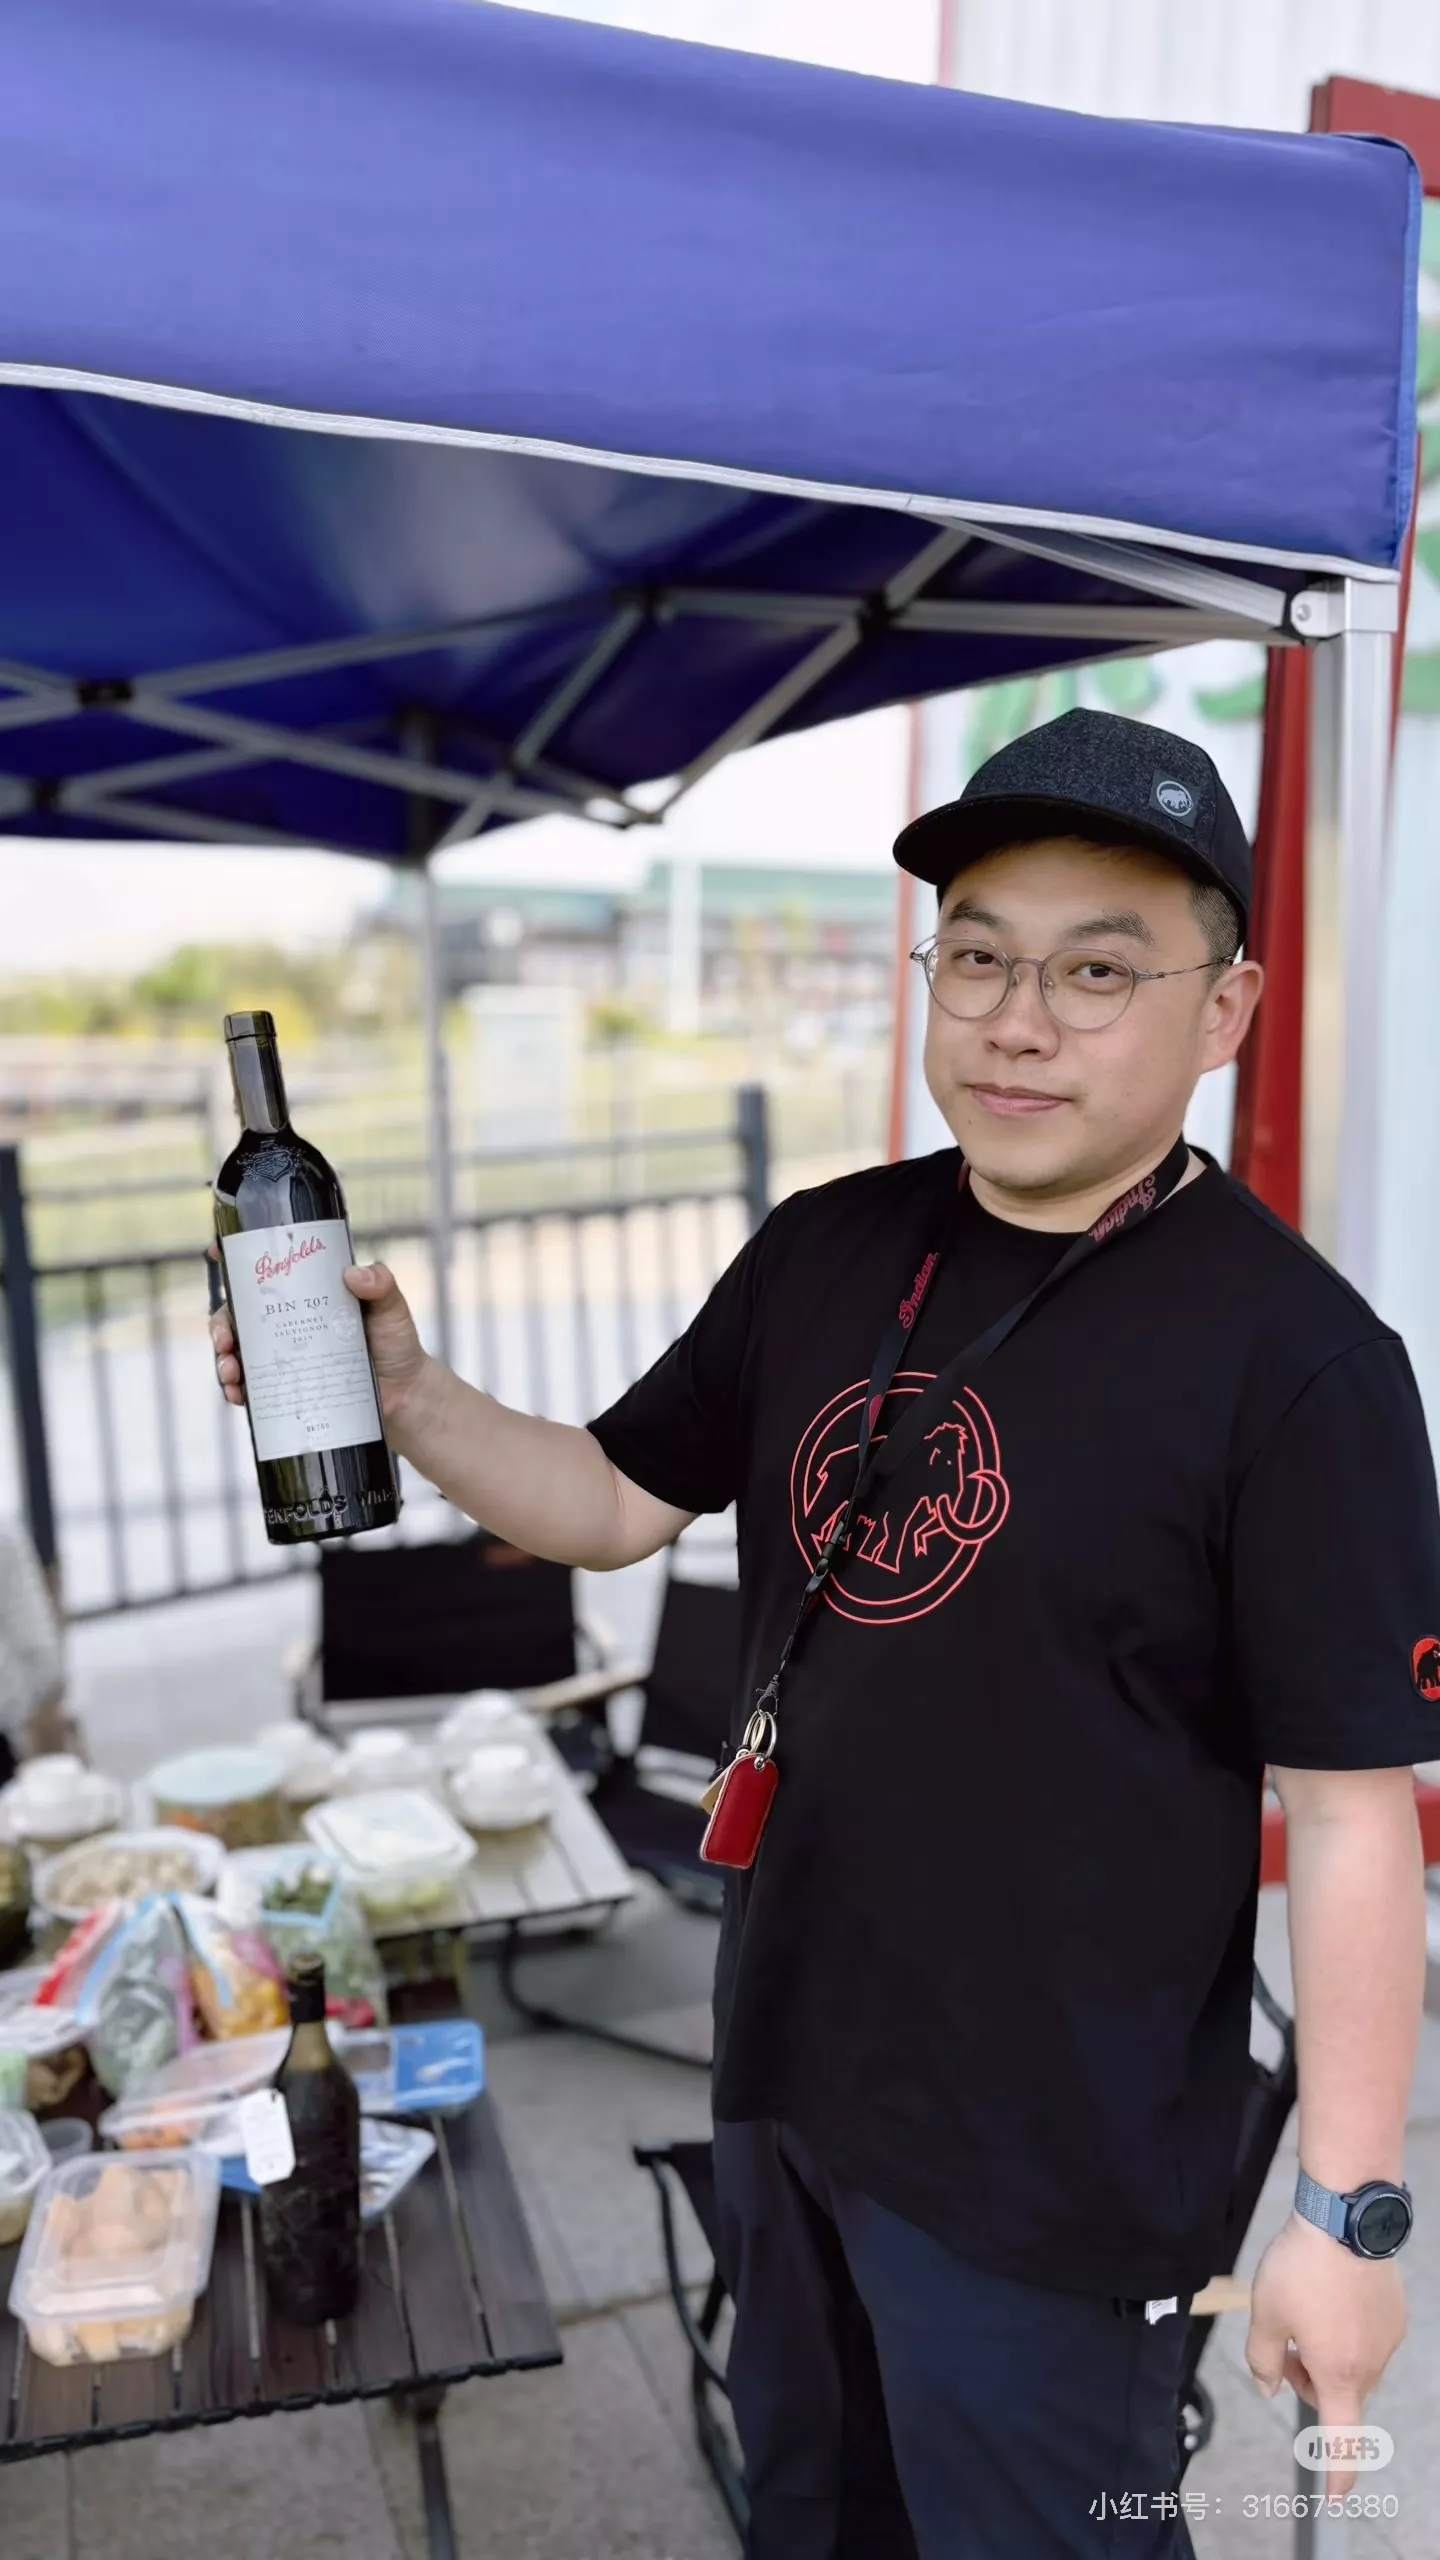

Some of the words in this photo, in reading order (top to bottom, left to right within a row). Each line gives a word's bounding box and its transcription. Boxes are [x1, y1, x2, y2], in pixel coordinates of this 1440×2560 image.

[1088, 1173, 1157, 1243] Indian
[265, 1300, 297, 1316] BIN
[303, 1295, 330, 1311] 707
[273, 1323, 329, 1338] SAUVIGNON
[275, 1315, 325, 1329] CABERNET
